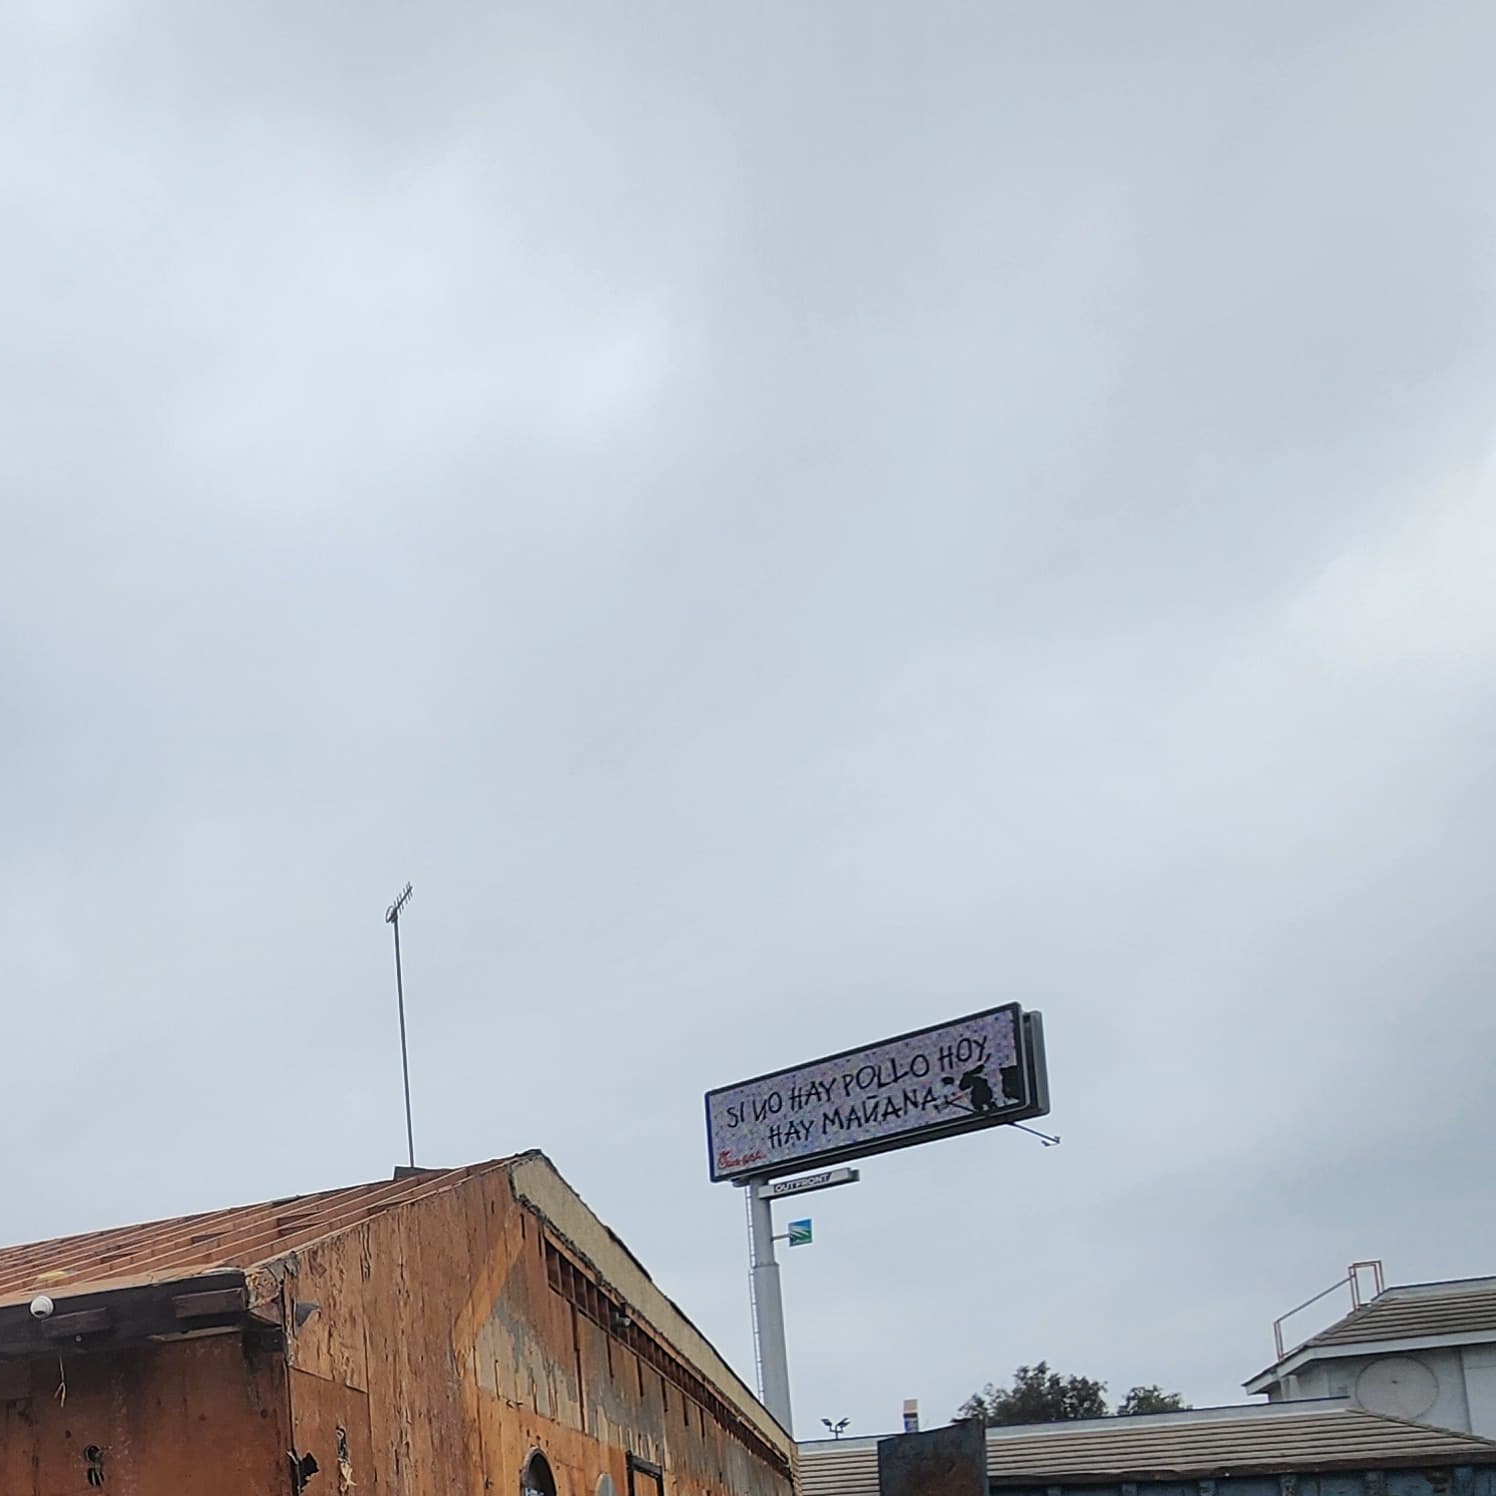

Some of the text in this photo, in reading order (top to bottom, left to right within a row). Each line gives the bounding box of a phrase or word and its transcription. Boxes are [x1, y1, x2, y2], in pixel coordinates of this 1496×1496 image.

[727, 1036, 992, 1128] SI NO HAY POLLO HOY,
[768, 1120, 816, 1149] HAY
[775, 1173, 829, 1192] OUTFRONT
